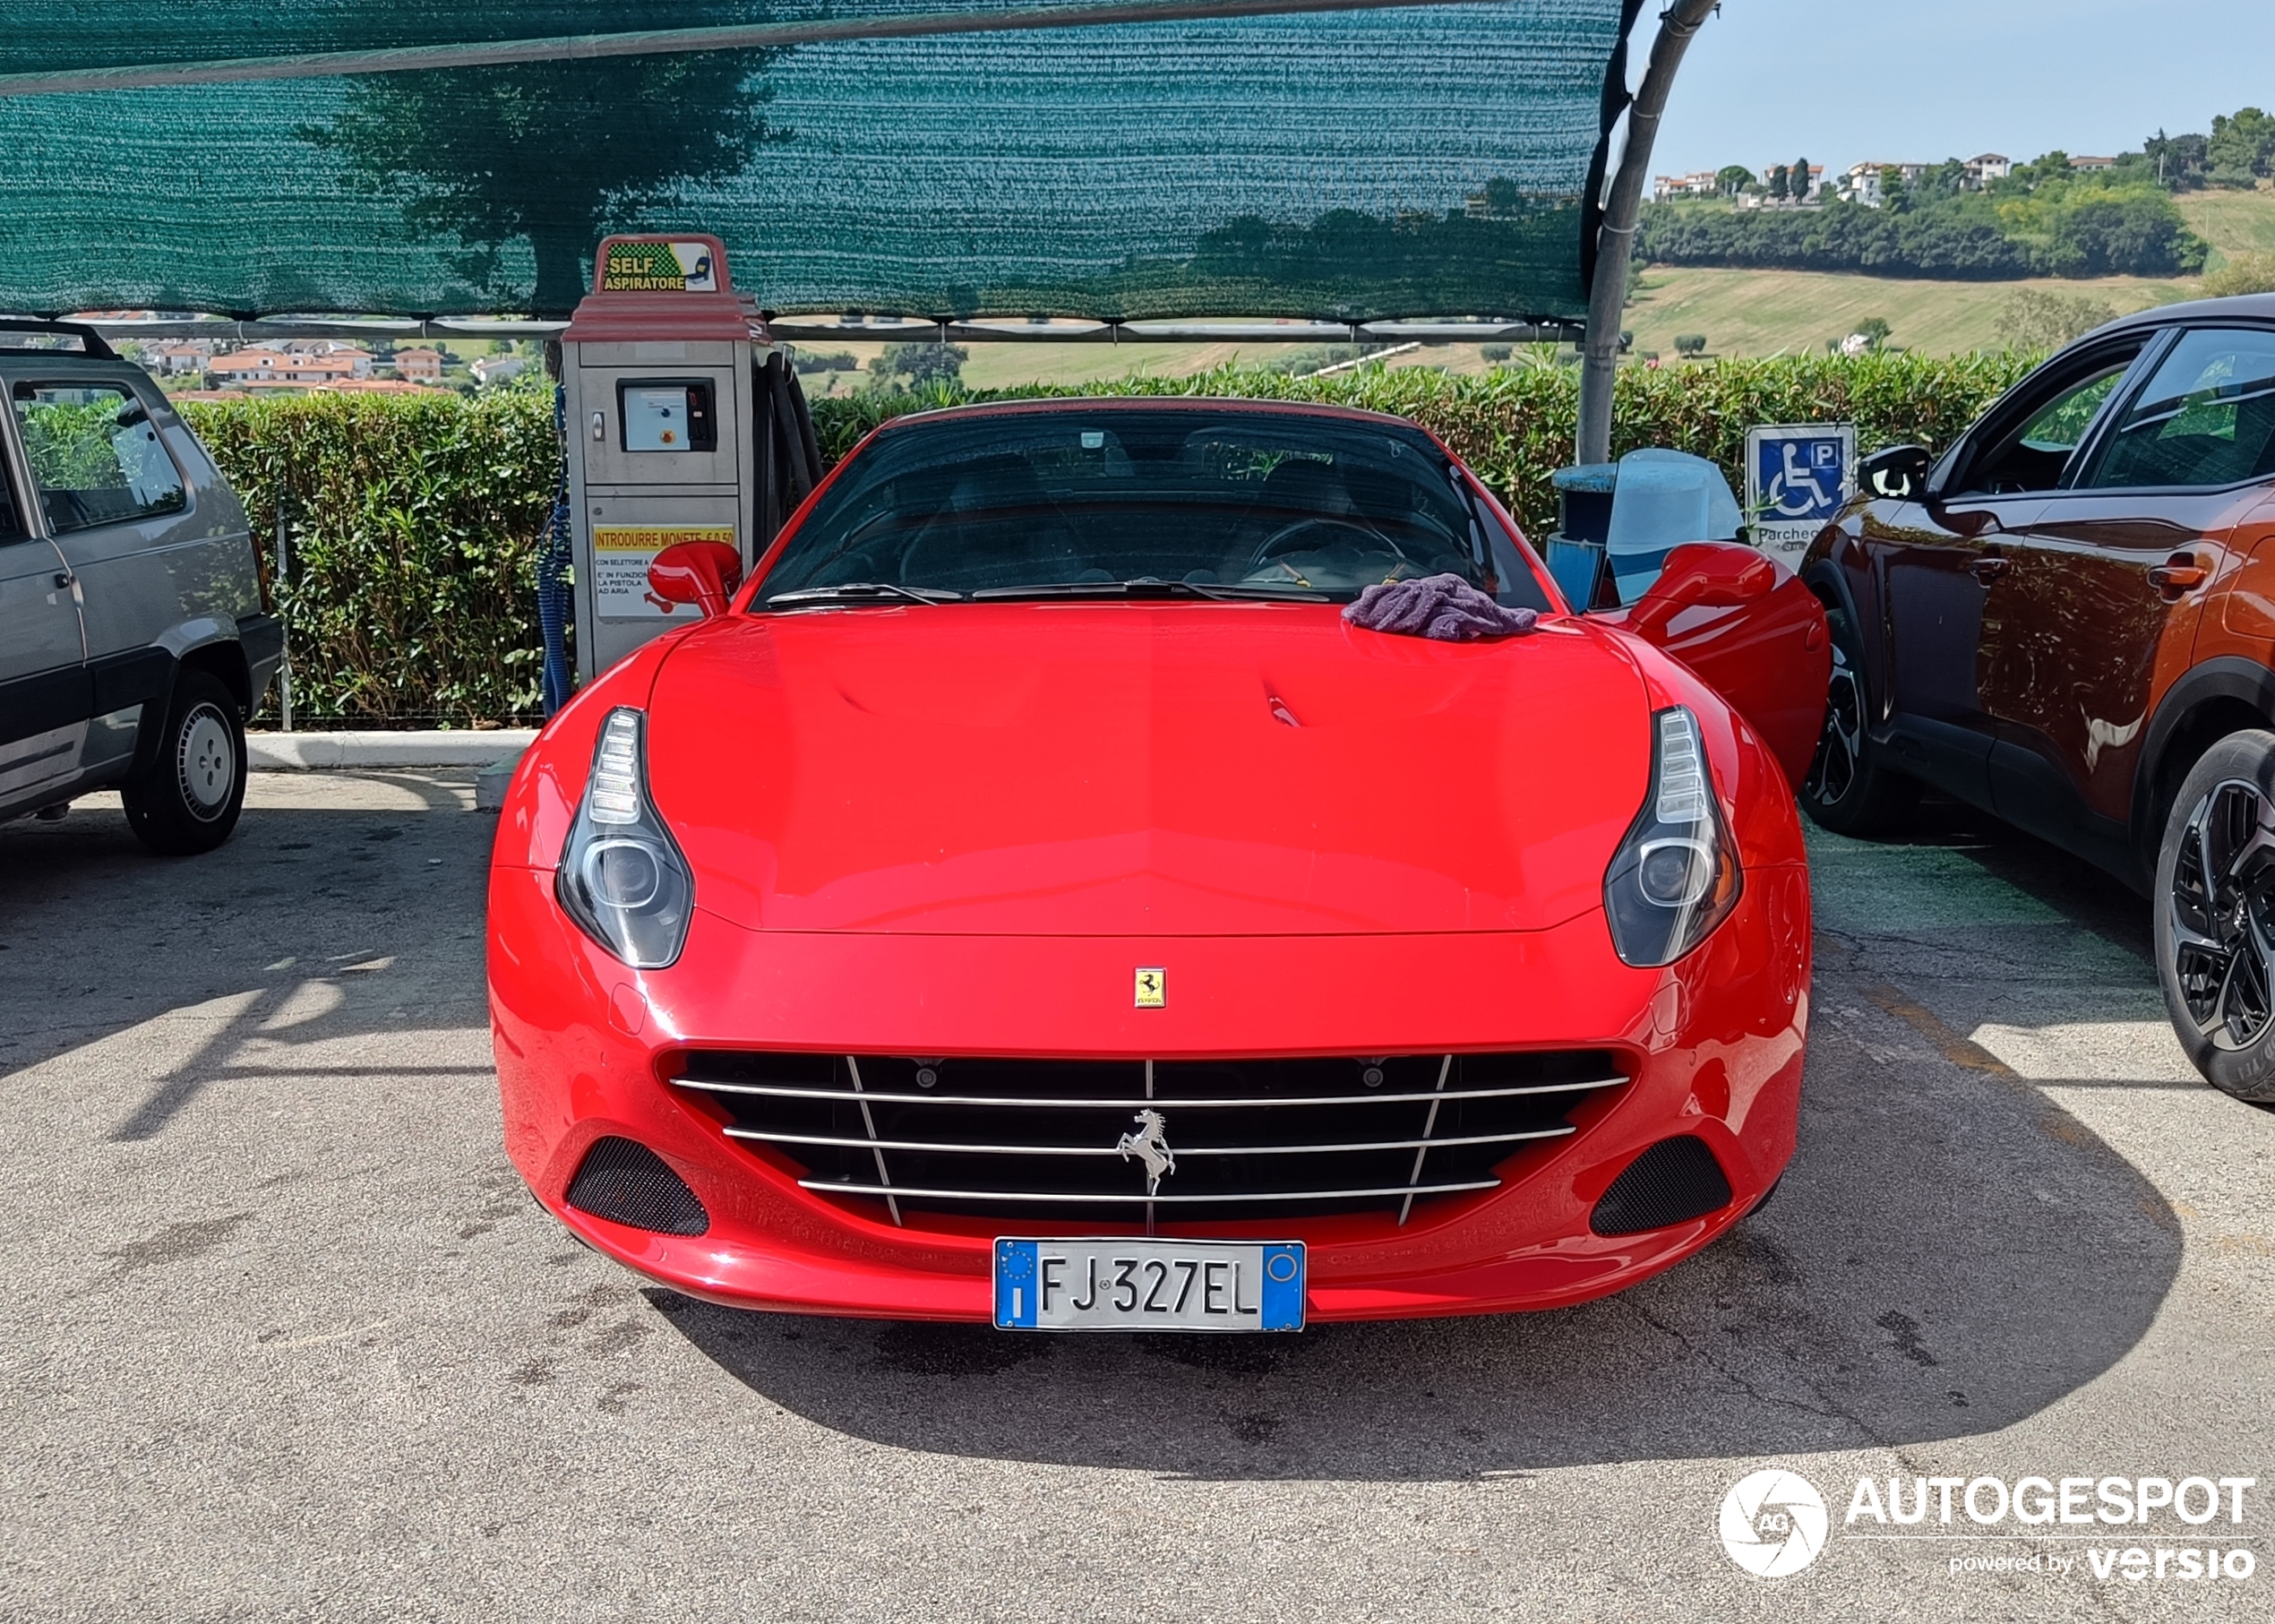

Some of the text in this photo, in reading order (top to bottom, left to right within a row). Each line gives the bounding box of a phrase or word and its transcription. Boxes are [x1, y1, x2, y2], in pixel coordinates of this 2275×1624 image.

[610, 257, 654, 274] SELF
[605, 277, 684, 289] ASPIRATORE
[1817, 445, 1833, 466] P
[596, 532, 658, 547] INTRODURRE
[661, 532, 701, 546] MONETE
